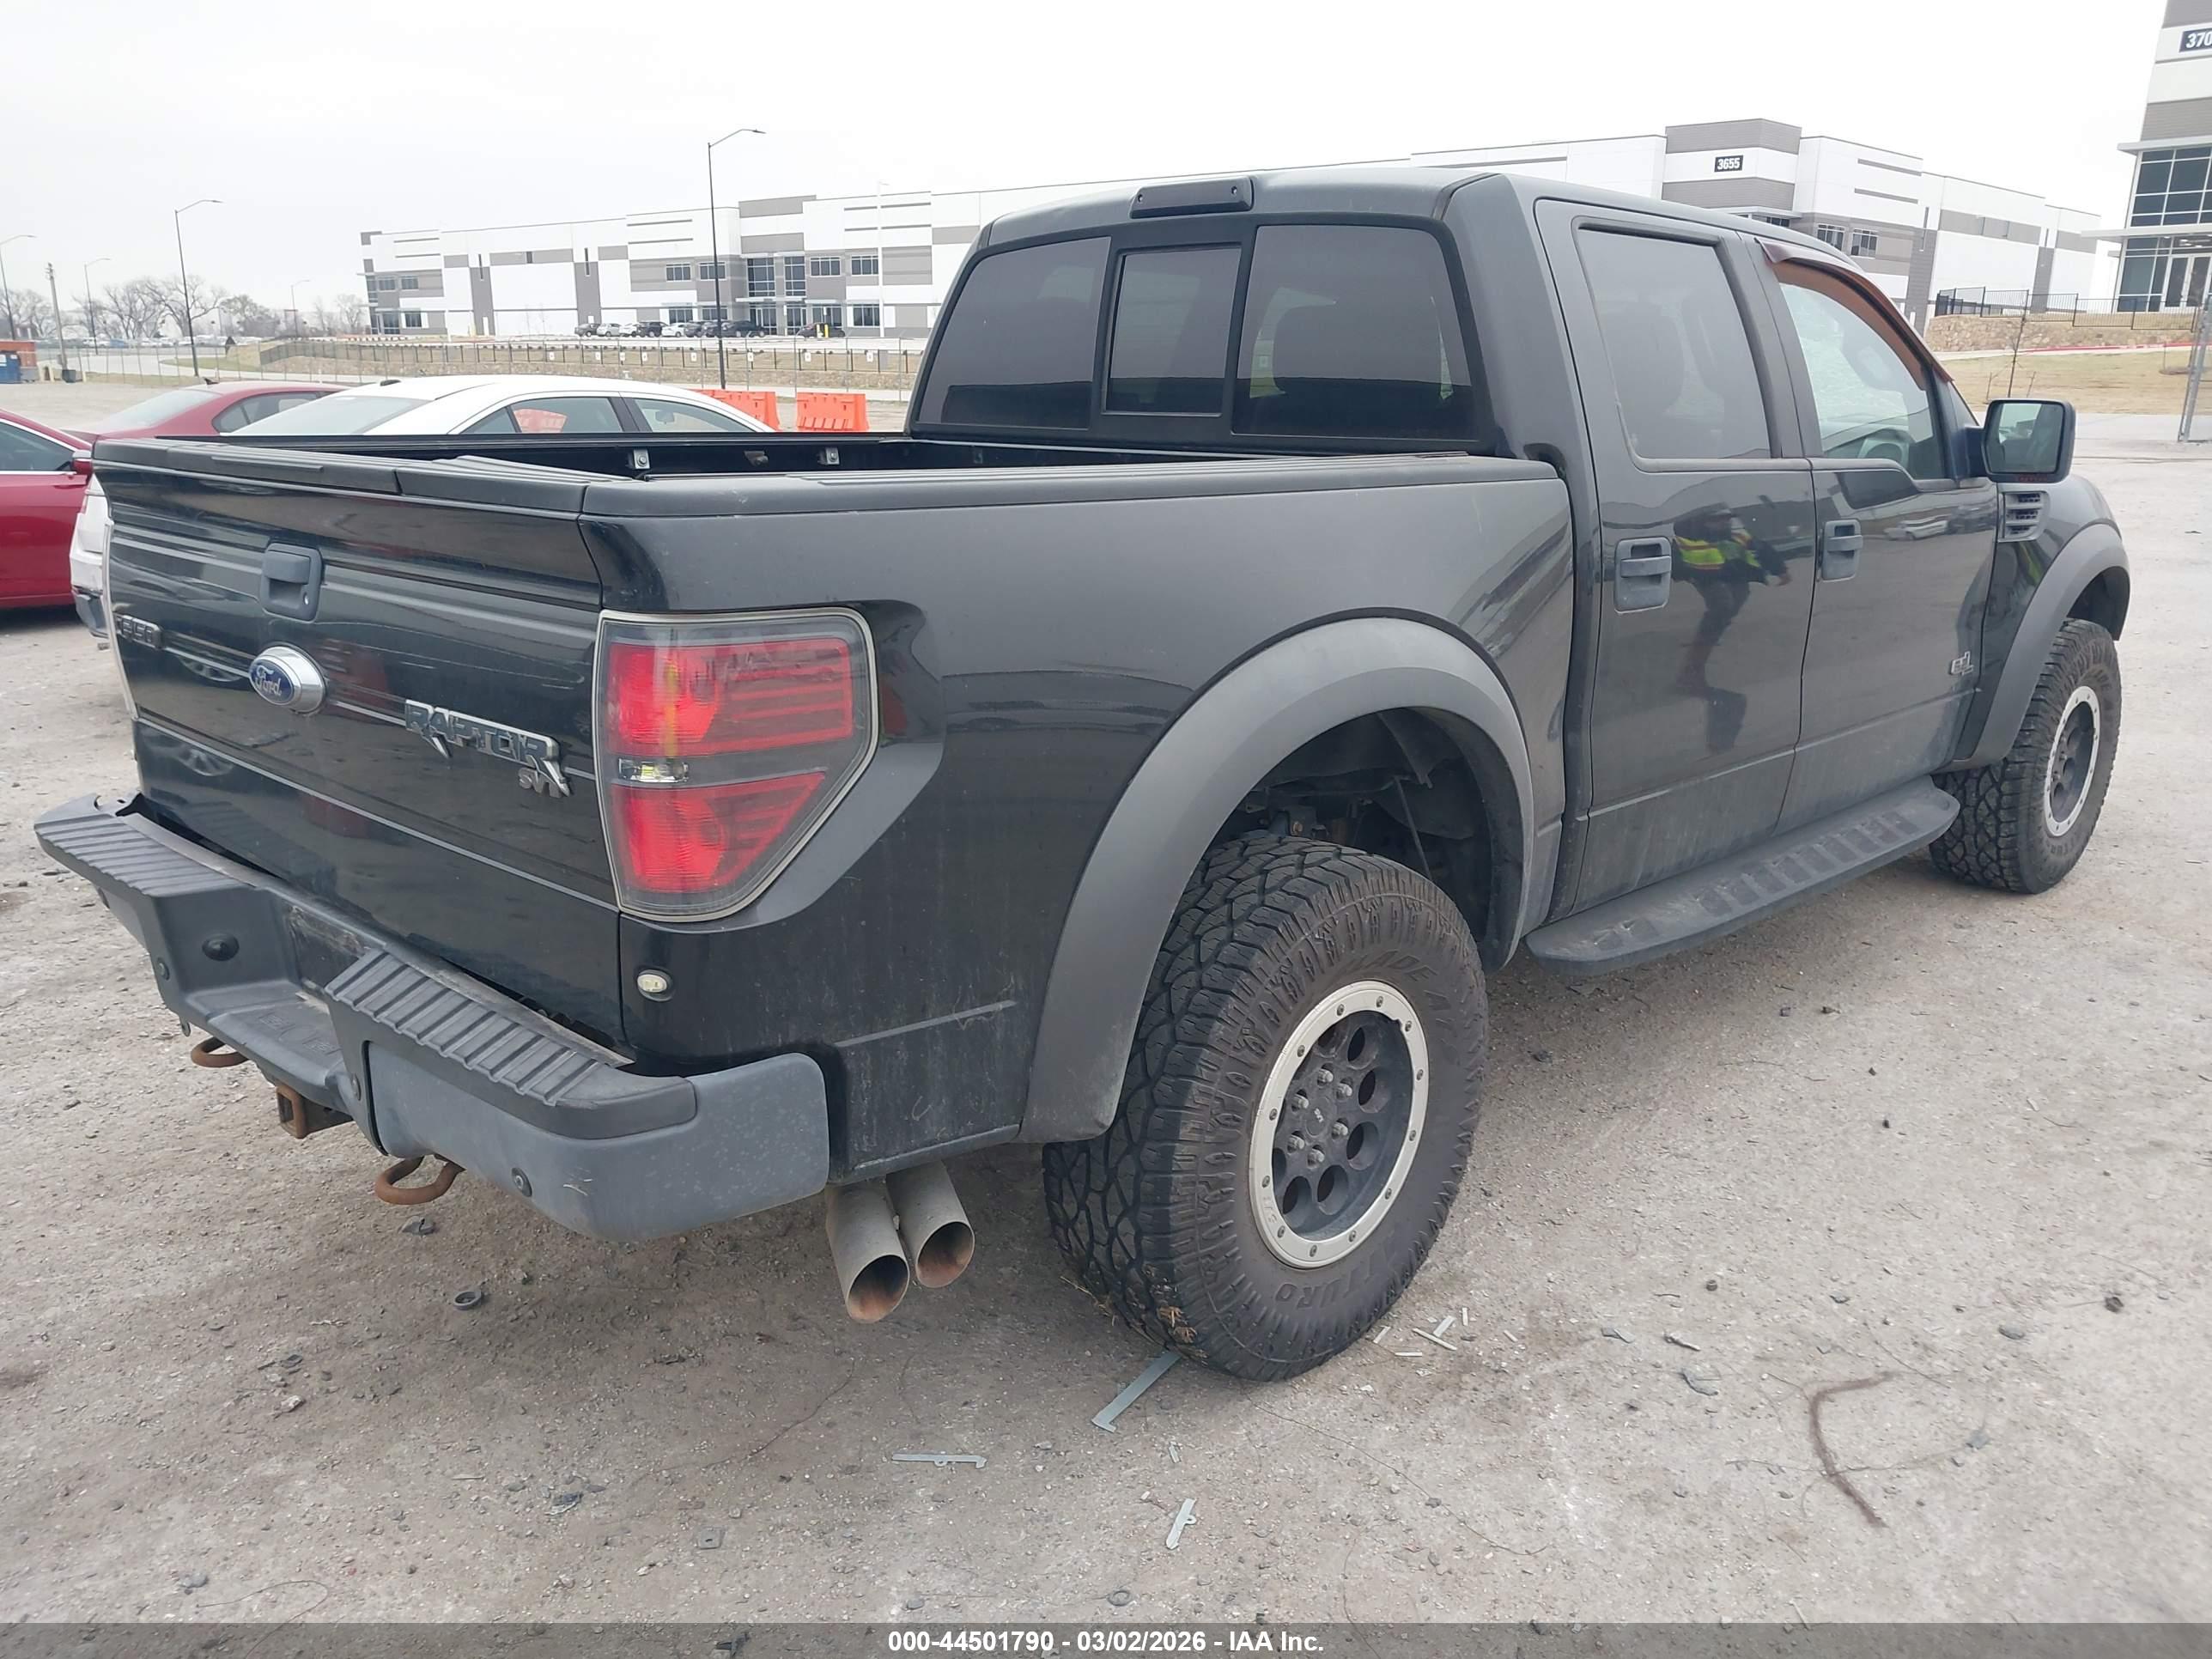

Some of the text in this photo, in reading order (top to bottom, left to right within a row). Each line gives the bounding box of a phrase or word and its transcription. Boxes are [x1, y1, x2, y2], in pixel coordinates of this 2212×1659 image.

[1717, 157, 1741, 170] 3655
[255, 664, 283, 697] Ford
[404, 698, 571, 798] RAPTOR
